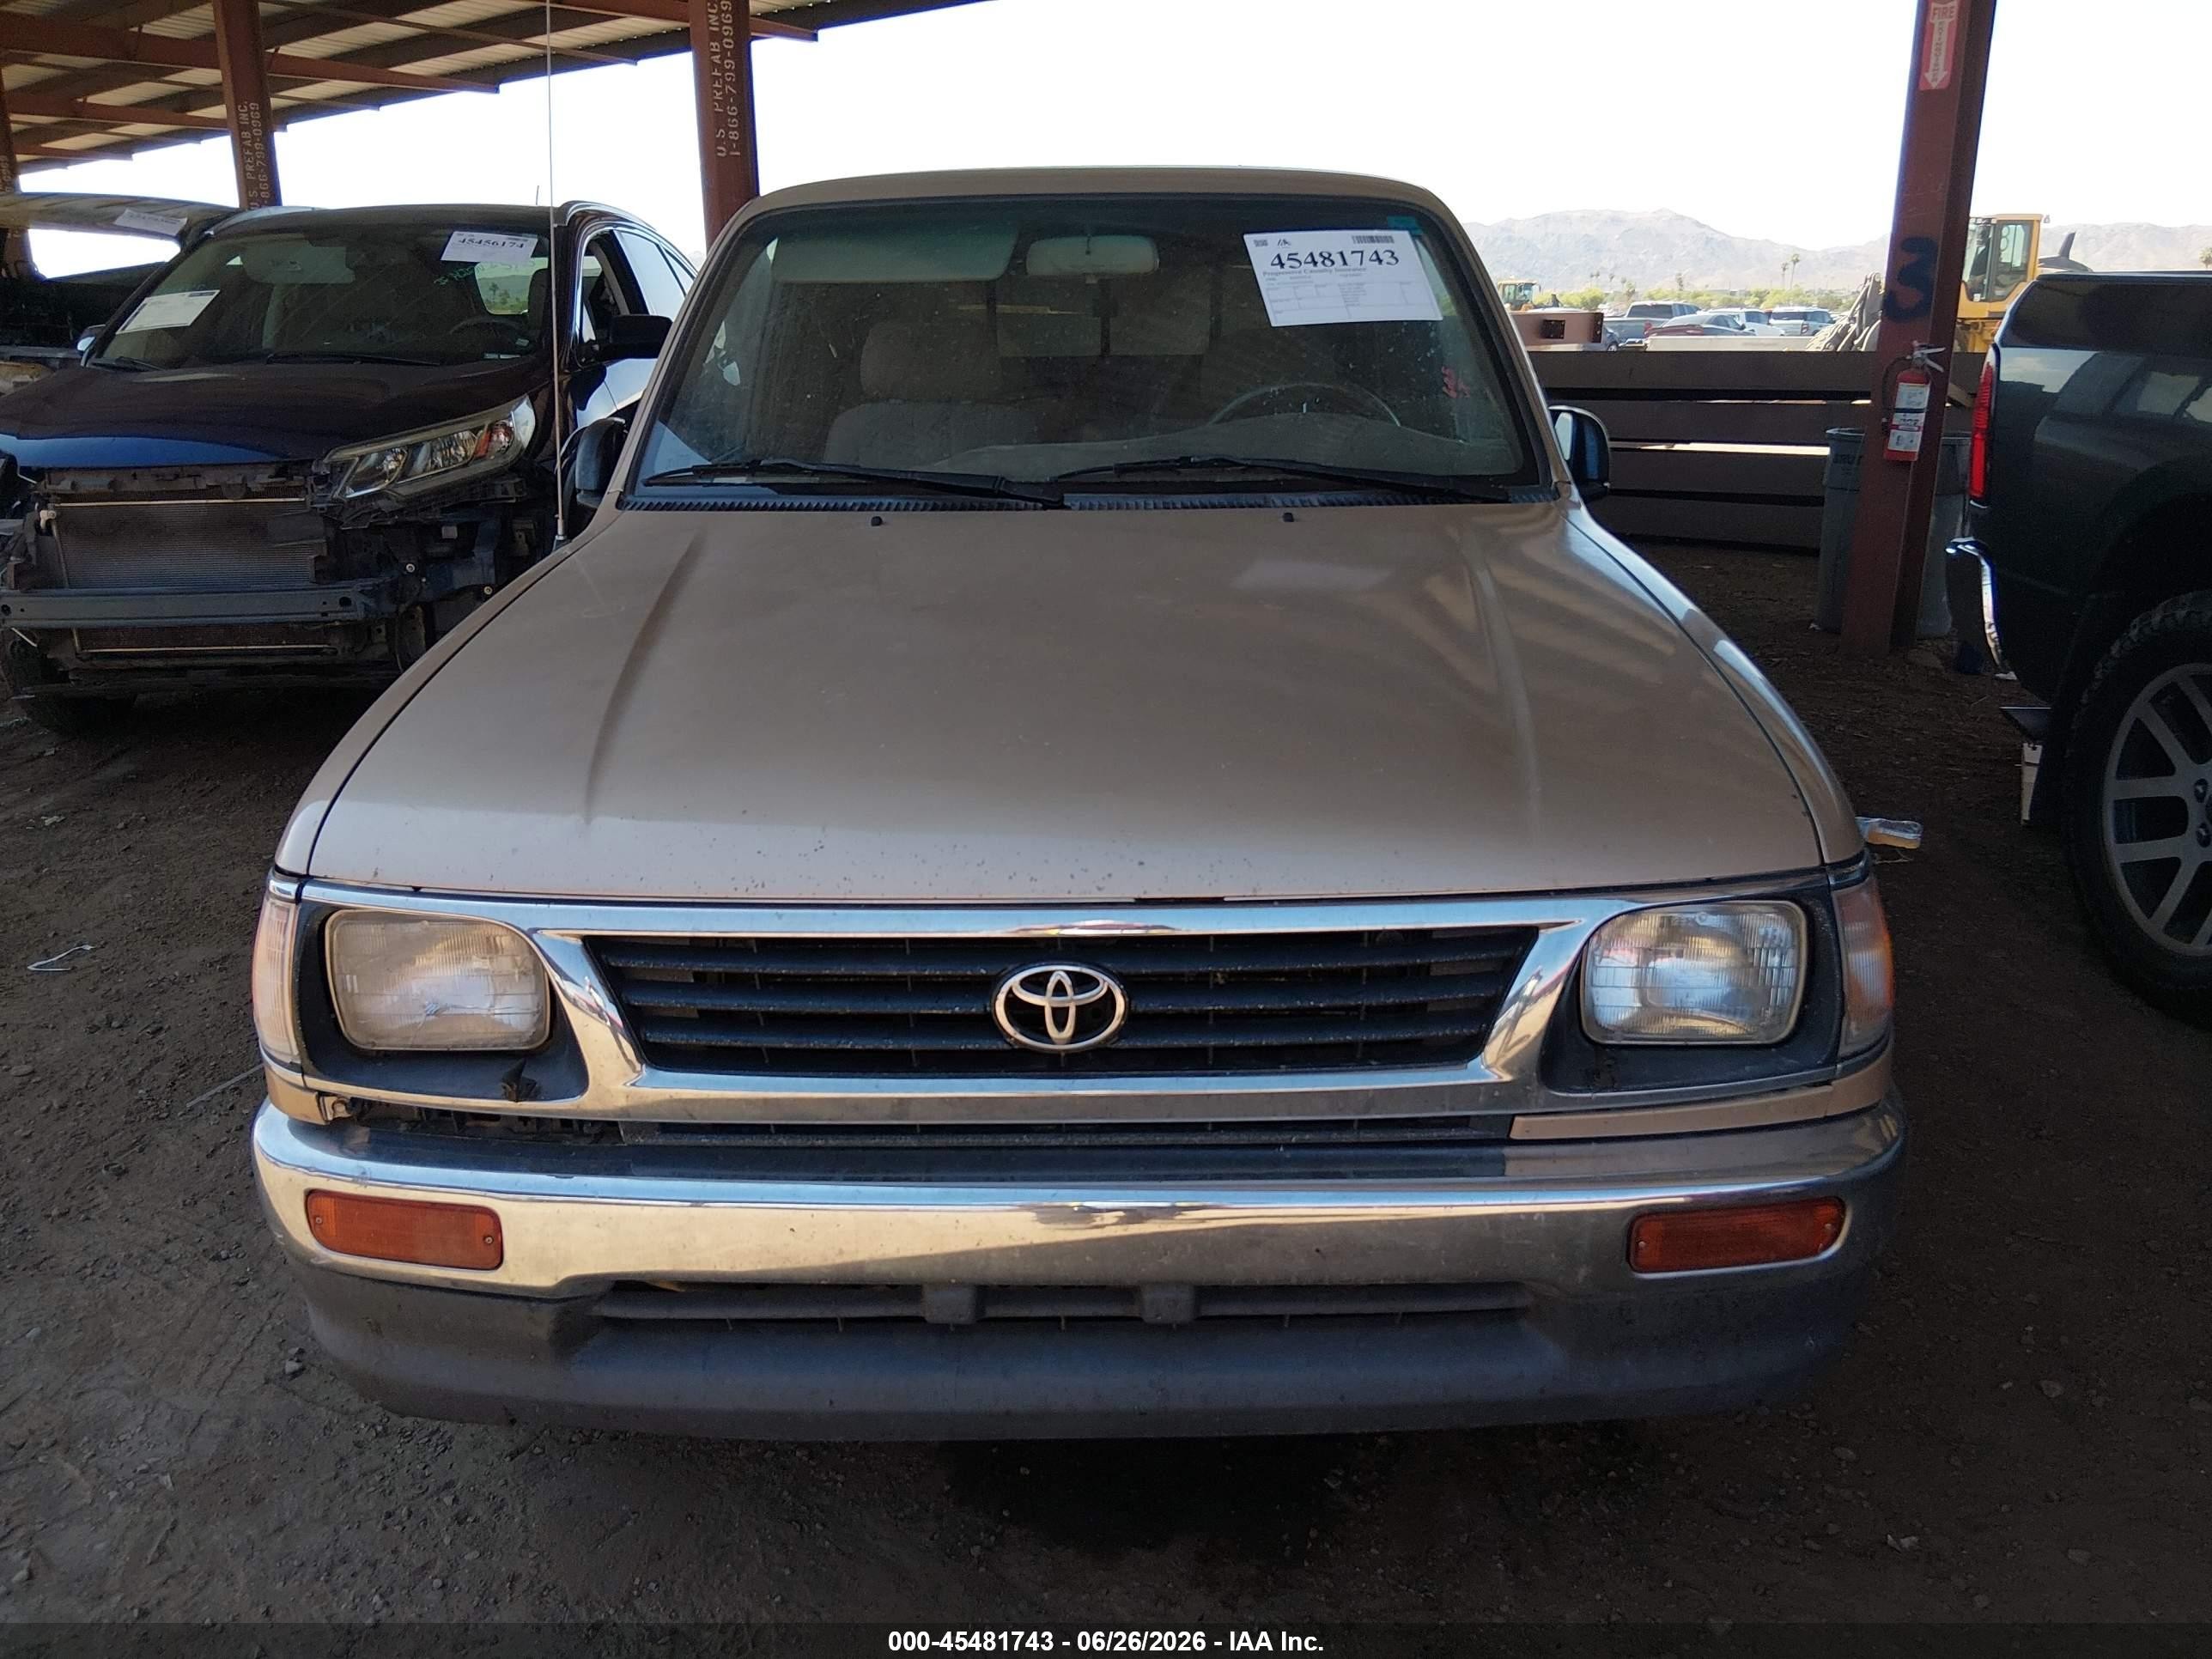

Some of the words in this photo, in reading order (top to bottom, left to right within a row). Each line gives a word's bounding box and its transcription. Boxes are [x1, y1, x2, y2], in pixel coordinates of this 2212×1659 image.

[1931, 6, 1955, 21] FIRE
[709, 41, 724, 112] PREFAB
[720, 0, 741, 155] 1-866-799-0969
[241, 131, 257, 179] PREFAB
[249, 102, 270, 204] -866-799-0969
[458, 238, 525, 248] 45456174
[1271, 249, 1400, 269] 45481743
[1883, 236, 1938, 324] 3
